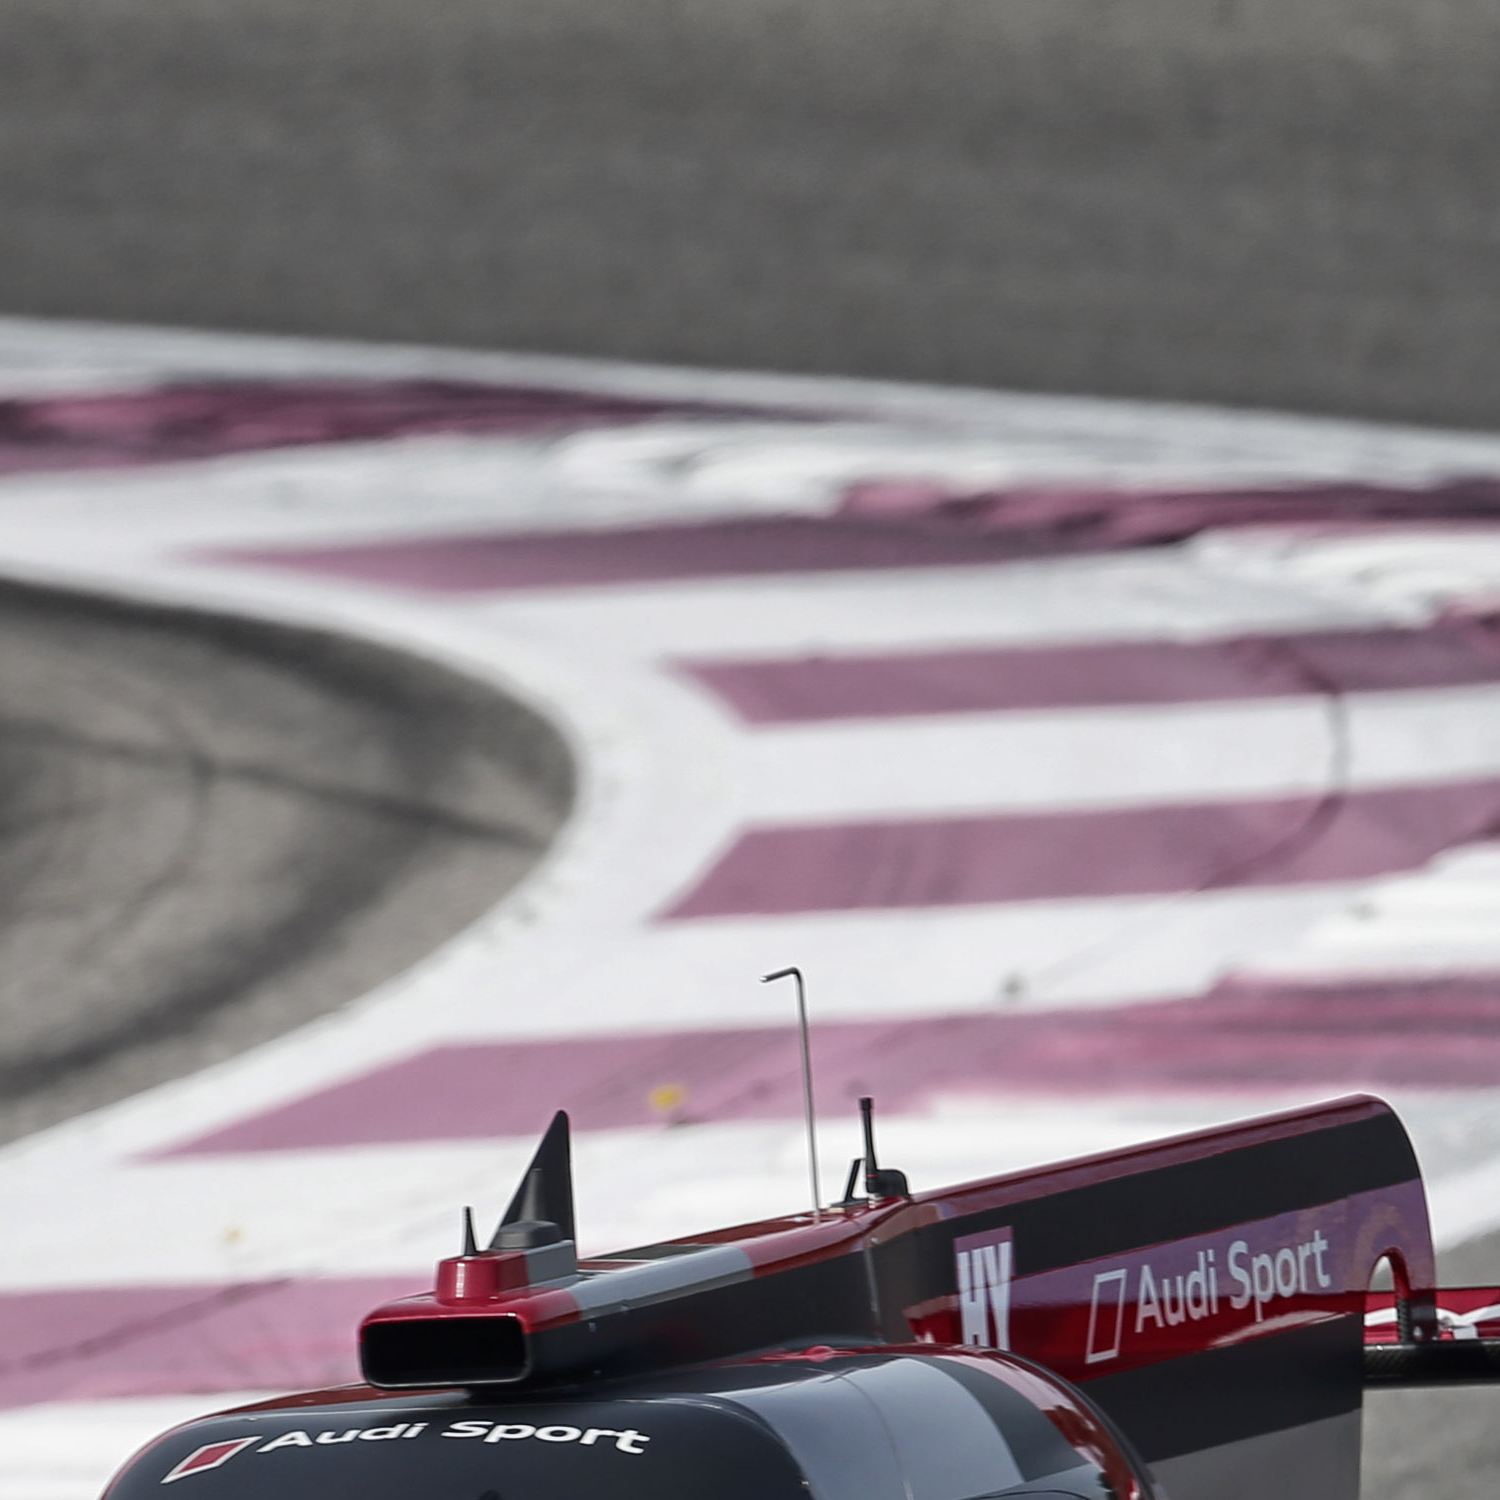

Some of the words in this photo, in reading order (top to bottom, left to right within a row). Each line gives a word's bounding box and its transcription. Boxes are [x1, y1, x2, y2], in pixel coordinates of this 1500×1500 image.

[956, 1241, 1013, 1352] HY
[1134, 1249, 1219, 1333] Audi
[1227, 1229, 1332, 1323] Sport
[256, 1421, 430, 1453] Audi
[441, 1420, 651, 1454] Sport
